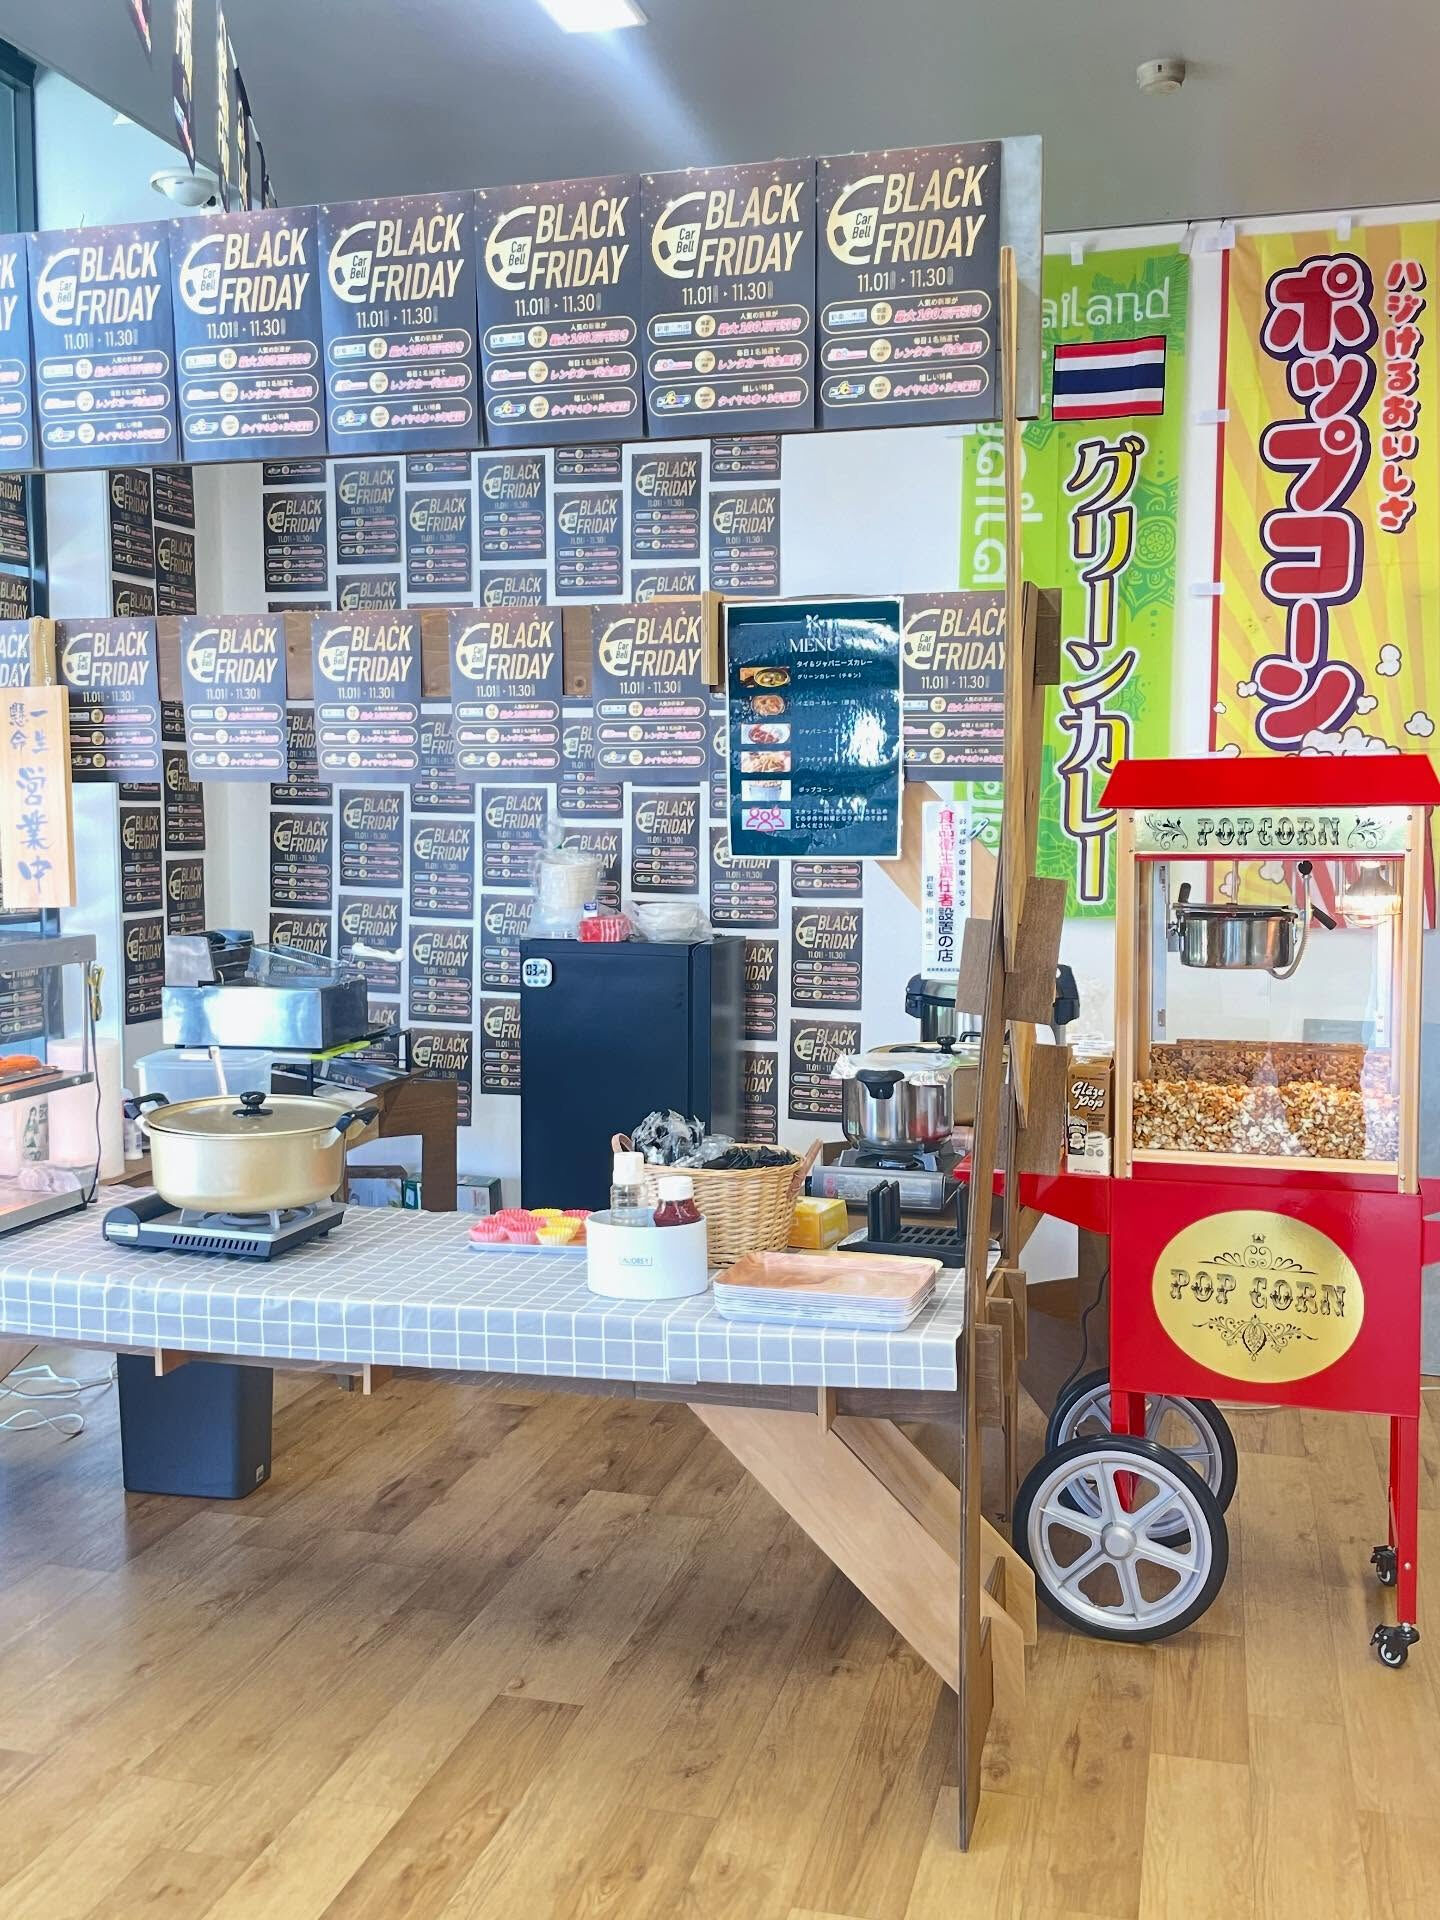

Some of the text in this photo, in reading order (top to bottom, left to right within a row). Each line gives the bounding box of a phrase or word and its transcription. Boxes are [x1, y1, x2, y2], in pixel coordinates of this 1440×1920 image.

[883, 164, 988, 215] BLACK
[705, 182, 805, 231] BLACK
[535, 197, 629, 244] BLACK
[855, 212, 872, 226] Car
[376, 213, 464, 259] BLACK
[679, 228, 695, 240] Car
[852, 224, 871, 240] Bell
[873, 214, 987, 265] FRIDAY
[224, 227, 309, 272] BLACK
[511, 241, 526, 253] Car
[676, 240, 695, 253] Bell
[697, 231, 803, 278] FRIDAY
[80, 240, 160, 284] BLACK
[352, 255, 367, 267] Car
[508, 252, 525, 266] Bell
[528, 244, 629, 291] FRIDAY
[202, 267, 217, 279] Car
[350, 266, 366, 280] Bell
[369, 259, 464, 303] FRIDAY
[200, 279, 216, 292] Bell
[219, 272, 310, 315] FRIDAY
[75, 284, 161, 326] FRIDAY
[1042, 276, 1171, 328] ailand
[1379, 258, 1428, 533] ハジけるおいしさ
[358, 469, 395, 486] BLACK
[503, 463, 541, 481] BLACK
[656, 460, 696, 479] BLACK
[125, 474, 148, 498] BLACK
[500, 481, 541, 500] FRIDAY
[653, 480, 697, 498] FRIDAY
[124, 495, 149, 516] FRIDAY
[355, 488, 395, 505] FRIDAY
[429, 497, 467, 514] BLACK
[1256, 253, 1379, 752] ポップコーン
[286, 499, 322, 516] BLACK
[579, 498, 617, 516] BLACK
[735, 497, 775, 516] BLACK
[283, 516, 322, 533] FRIDAY
[426, 515, 467, 532] FRIDAY
[576, 516, 617, 535] FRIDAY
[732, 517, 775, 535] FRIDAY
[170, 537, 193, 558] BLACK
[169, 555, 193, 577] FRIDAY
[358, 581, 397, 598] BLACK
[504, 576, 541, 593] BLACK
[656, 575, 696, 593] BLACK
[130, 591, 153, 615] BLACK
[351, 623, 413, 652] BLACK
[489, 621, 555, 649] BLACK
[636, 615, 702, 645] BLACK
[919, 634, 932, 642] Car
[93, 630, 150, 658] BLACK
[219, 627, 277, 655] BLACK
[617, 641, 629, 650] Car
[789, 638, 839, 653] MENU
[917, 642, 931, 651] Bell
[214, 658, 278, 684] FRIDAY
[347, 655, 413, 682] FRIDAY
[485, 652, 555, 680] FRIDAY
[630, 648, 702, 677] FRIDAY
[1060, 434, 1145, 904] グリーンカレー
[90, 660, 149, 686] FRIDAY
[363, 797, 400, 815] BLACK
[506, 796, 543, 812] BLACK
[656, 800, 696, 818] BLACK
[15, 766, 53, 894] 営業中
[135, 814, 159, 831] BLACK
[292, 819, 328, 837] BLACK
[360, 814, 400, 832] FRIDAY
[503, 813, 543, 830] FRIDAY
[653, 818, 696, 835] FRIDAY
[434, 827, 470, 844] BLACK
[1196, 816, 1341, 847] POPCORN
[134, 833, 159, 851] FRIDAY
[289, 837, 328, 853] FRIDAY
[580, 832, 618, 851] BLACK
[430, 844, 470, 862] FRIDAY
[181, 865, 203, 883] BLACK
[180, 882, 203, 900] FRIDAY
[937, 809, 955, 963] 食品衛生責任者設置の店
[361, 903, 398, 921] BLACK
[292, 920, 328, 939] BLACK
[358, 920, 398, 937] FRIDAY
[817, 914, 858, 933] BLACK
[138, 923, 162, 943] BLACK
[432, 932, 469, 950] BLACK
[814, 932, 858, 950] FRIDAY
[138, 942, 163, 962] FRIDAY
[429, 949, 469, 967] FRIDAY
[432, 1035, 469, 1054] BLACK
[816, 1029, 857, 1047] BLACK
[429, 1053, 469, 1070] FRIDAY
[1169, 1268, 1347, 1318] POP CORN
